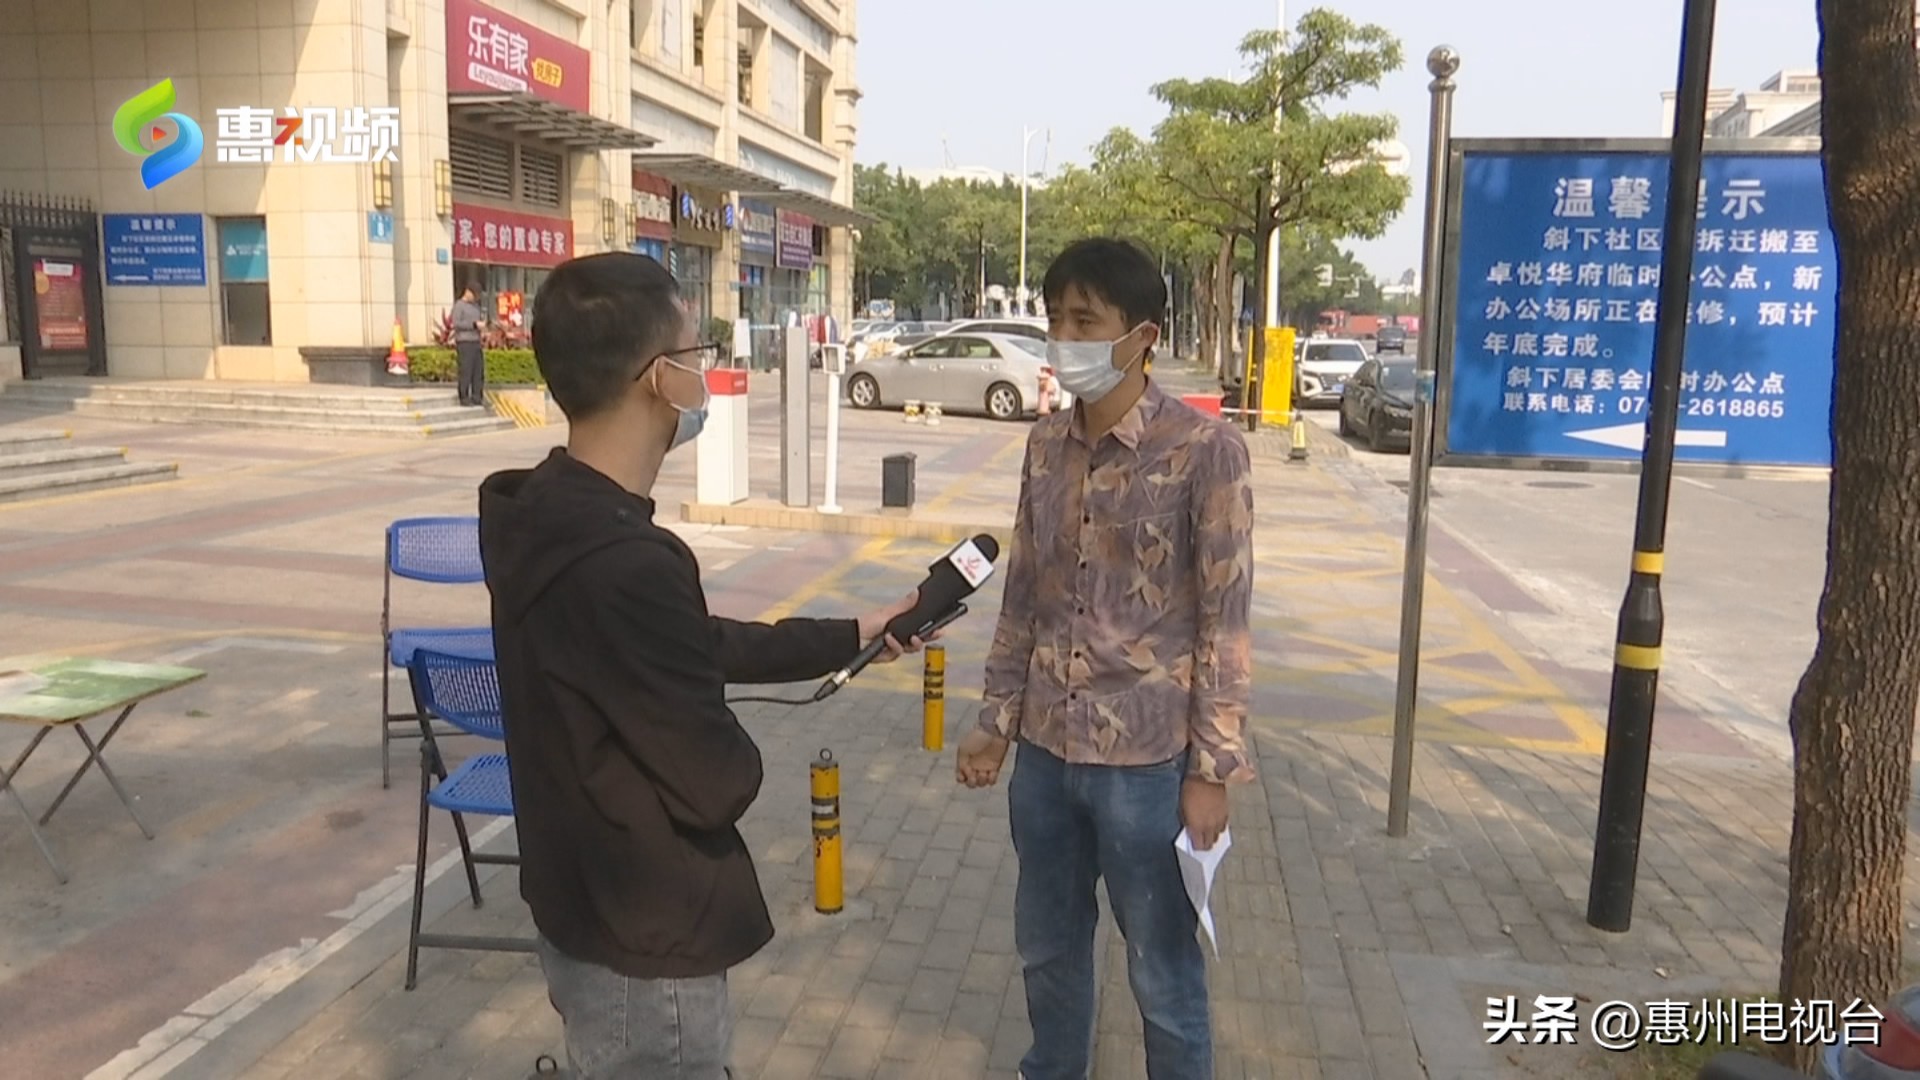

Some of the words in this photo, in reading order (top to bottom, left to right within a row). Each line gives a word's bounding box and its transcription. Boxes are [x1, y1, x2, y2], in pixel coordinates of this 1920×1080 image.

[468, 15, 528, 76] 乐有家
[1543, 226, 1820, 254] 斜下社区拆迁搬至
[1486, 262, 1823, 291] 卓悦华府临时公点，新
[1484, 297, 1818, 327] 办公场所正在修，预计
[1482, 331, 1614, 359] 年底完成。
[1506, 366, 1786, 394] 斜下居委会时办公点
